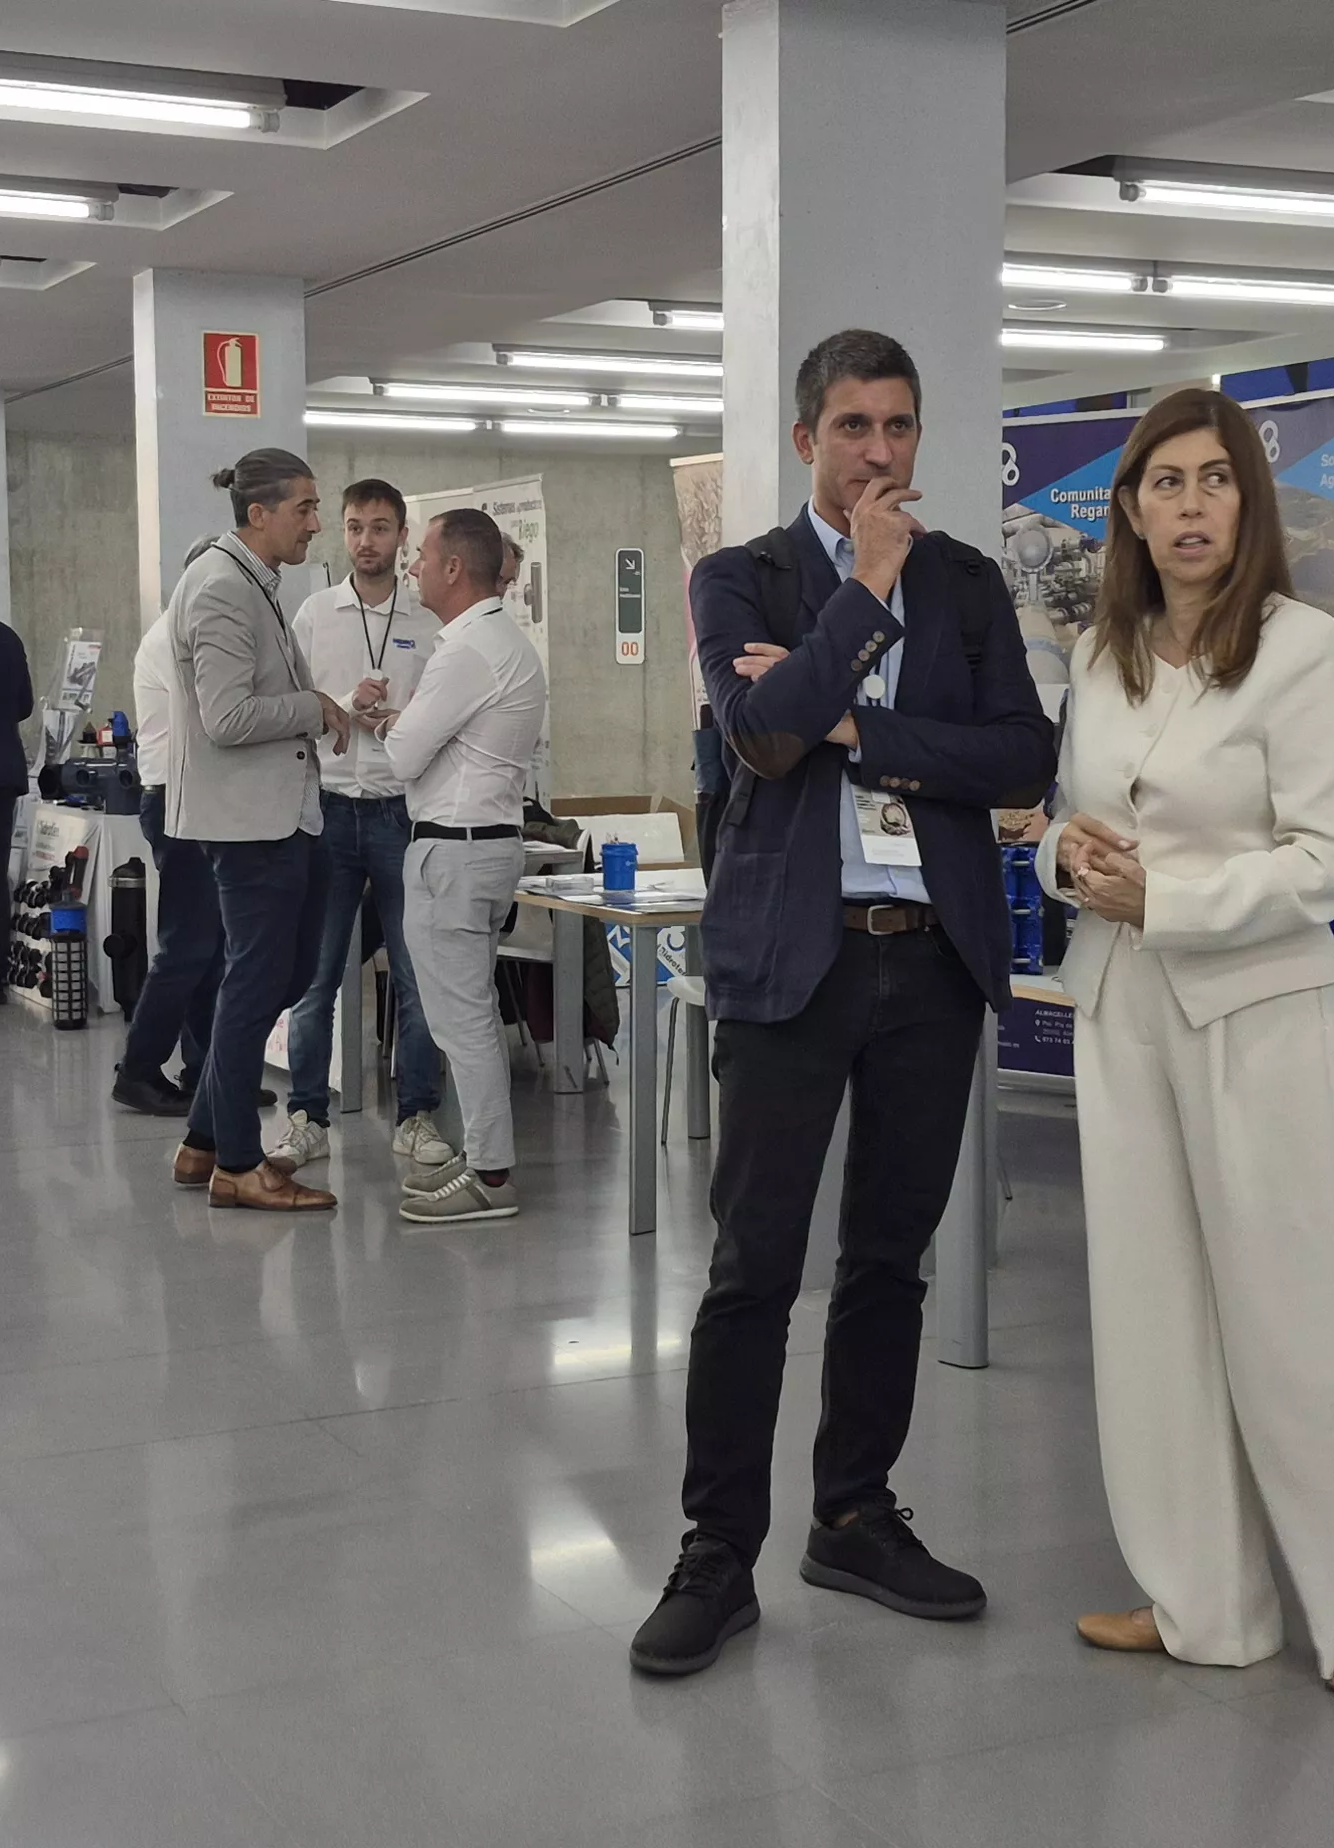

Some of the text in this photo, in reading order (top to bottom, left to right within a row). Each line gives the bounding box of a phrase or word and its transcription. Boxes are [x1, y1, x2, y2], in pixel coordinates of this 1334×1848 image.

[1050, 486, 1111, 503] Comunita
[621, 642, 638, 656] 00
[1035, 1009, 1072, 1018] ALMACELLE
